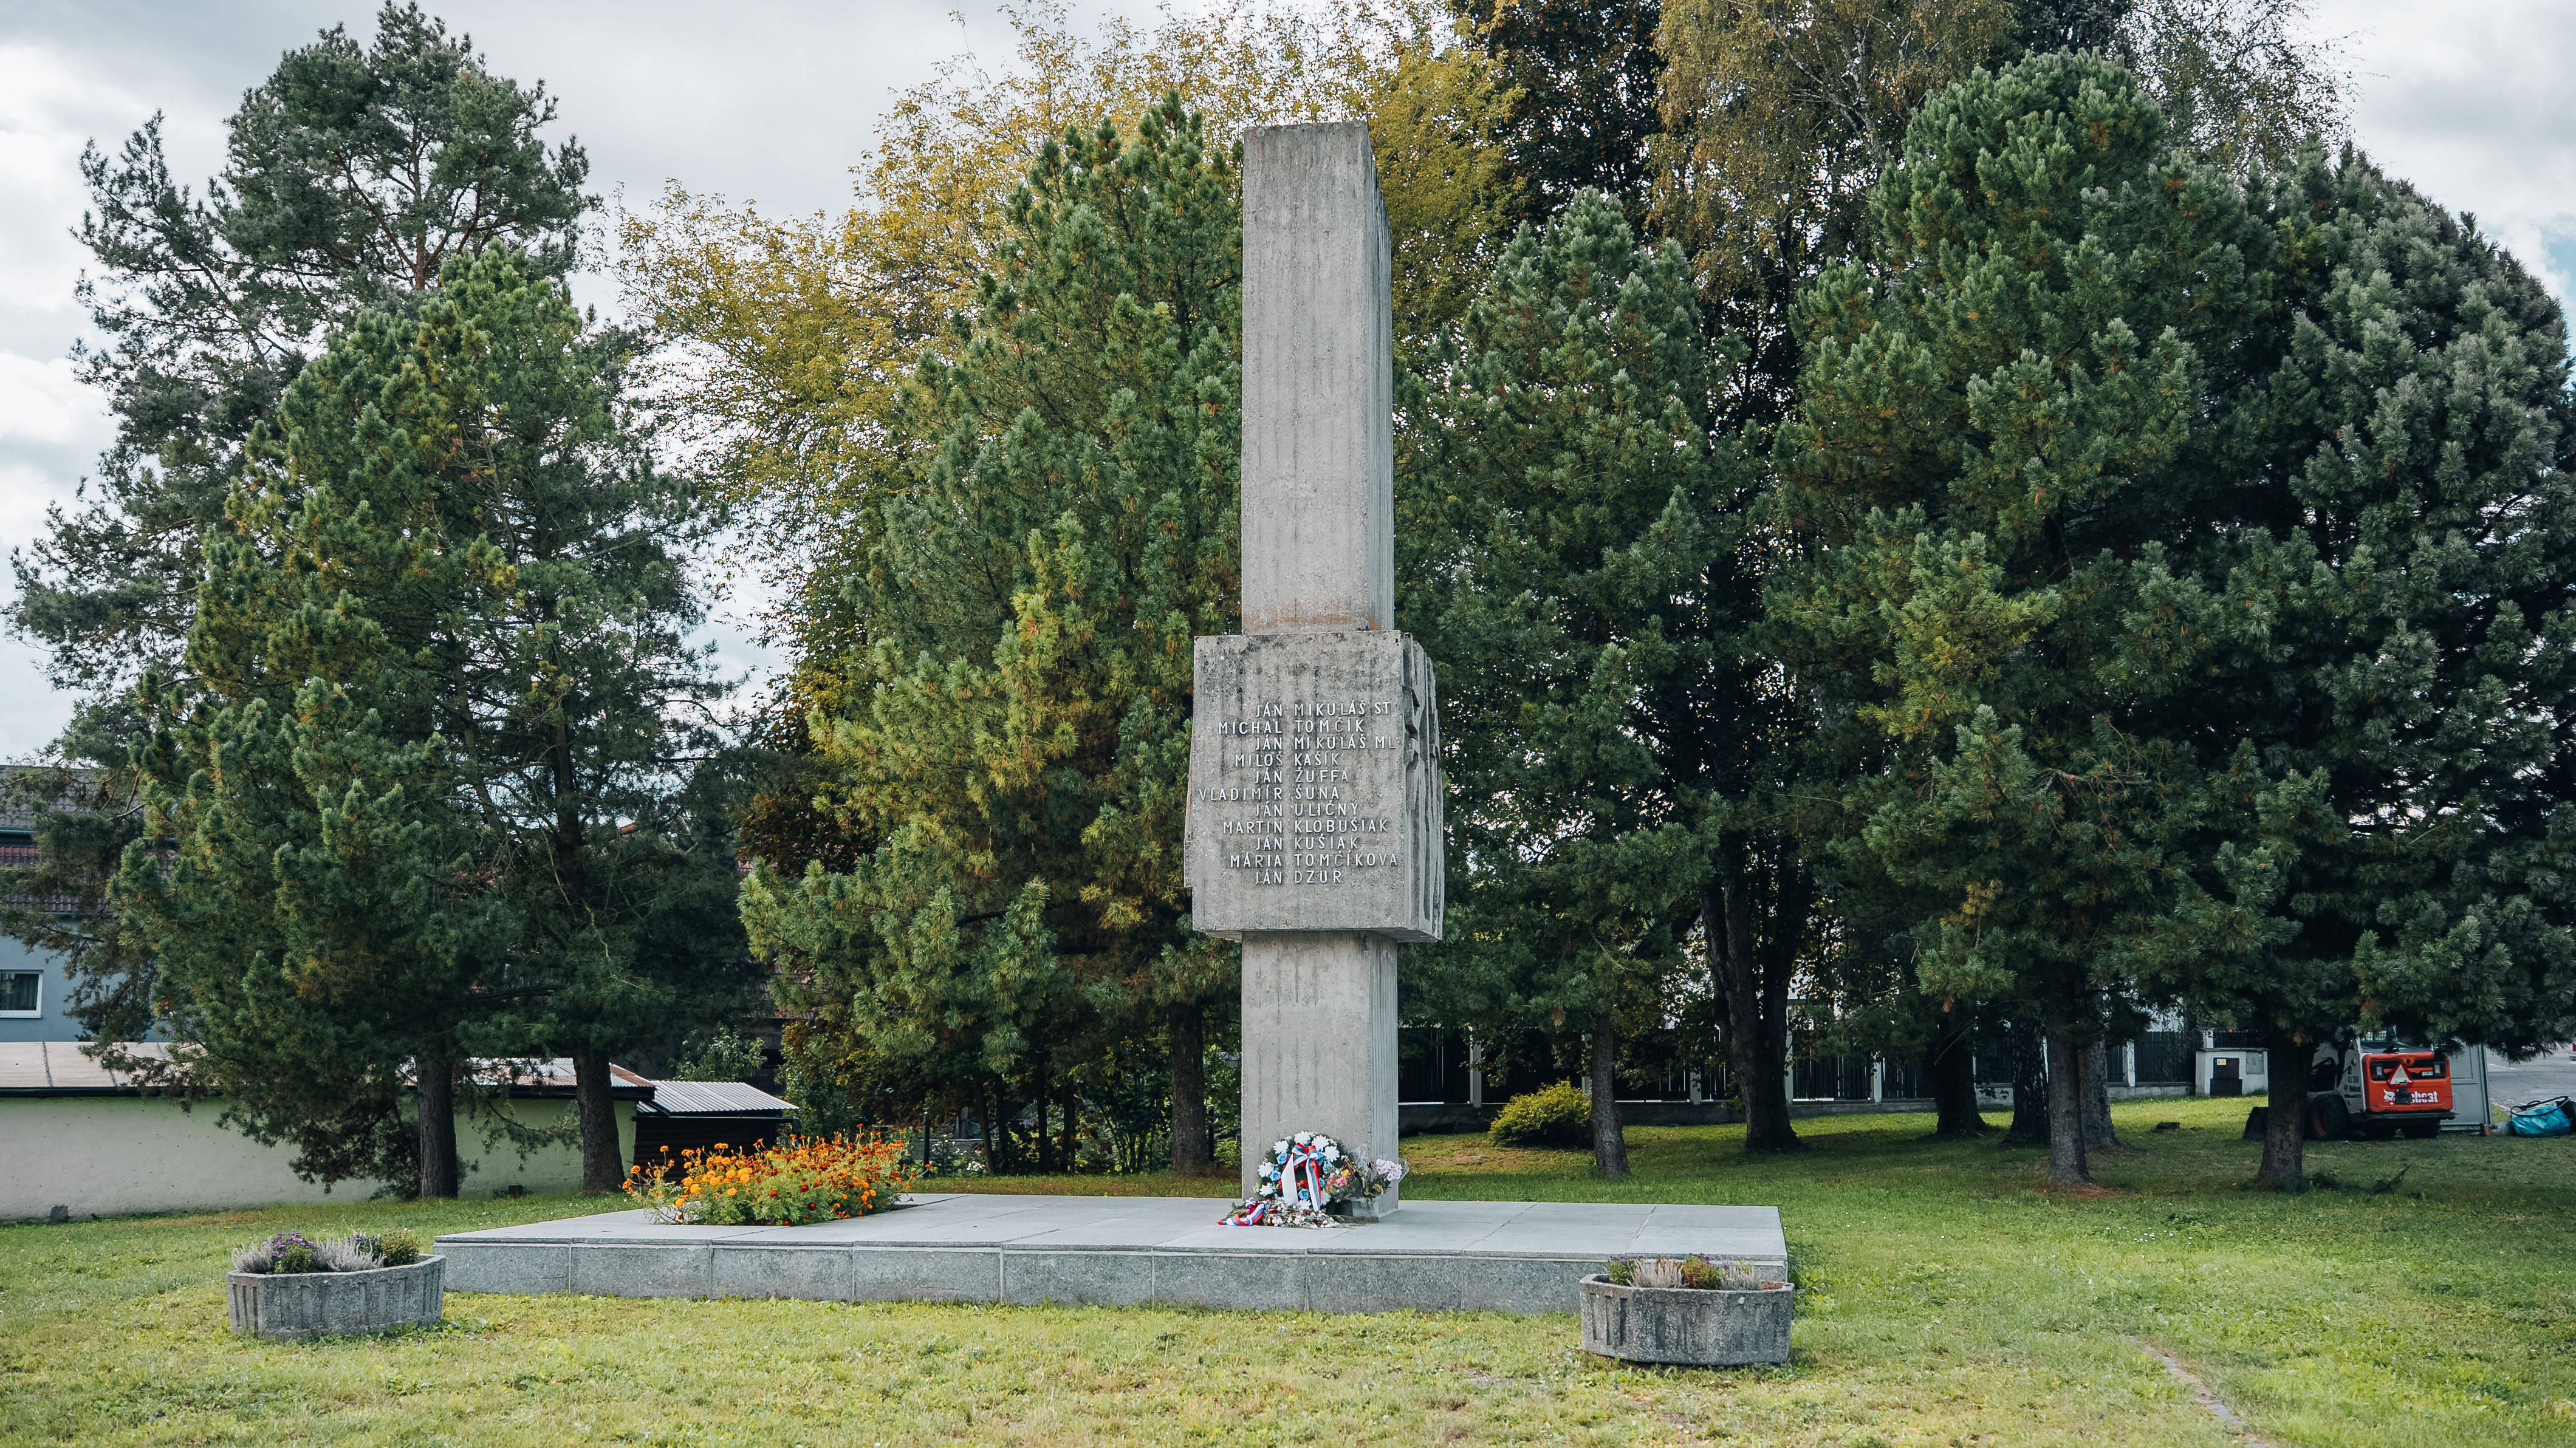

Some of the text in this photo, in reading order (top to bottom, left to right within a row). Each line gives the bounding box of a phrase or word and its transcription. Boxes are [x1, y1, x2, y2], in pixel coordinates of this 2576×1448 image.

[1255, 700, 1391, 717] JÁN MIKULÁŠ ST
[1218, 718, 1364, 734] MICHAL TOMČÍK
[1255, 734, 1396, 750] JÁN MIKULÁŠ ML
[1235, 751, 1339, 767] MILOŠ KAŠÍK
[1255, 767, 1348, 784] JÁN ŽUFFA
[1199, 785, 1339, 801] VLADIMÍR ŠUNA
[1255, 803, 1283, 817] JÁN
[1223, 818, 1388, 834] MARTIN KLOBUŠIAK
[1256, 833, 1358, 850] JÁN KUŠIAK
[1230, 851, 1397, 868] MÁRIA TOMČÍKOVA
[1255, 870, 1342, 885] JÁN DZUR
